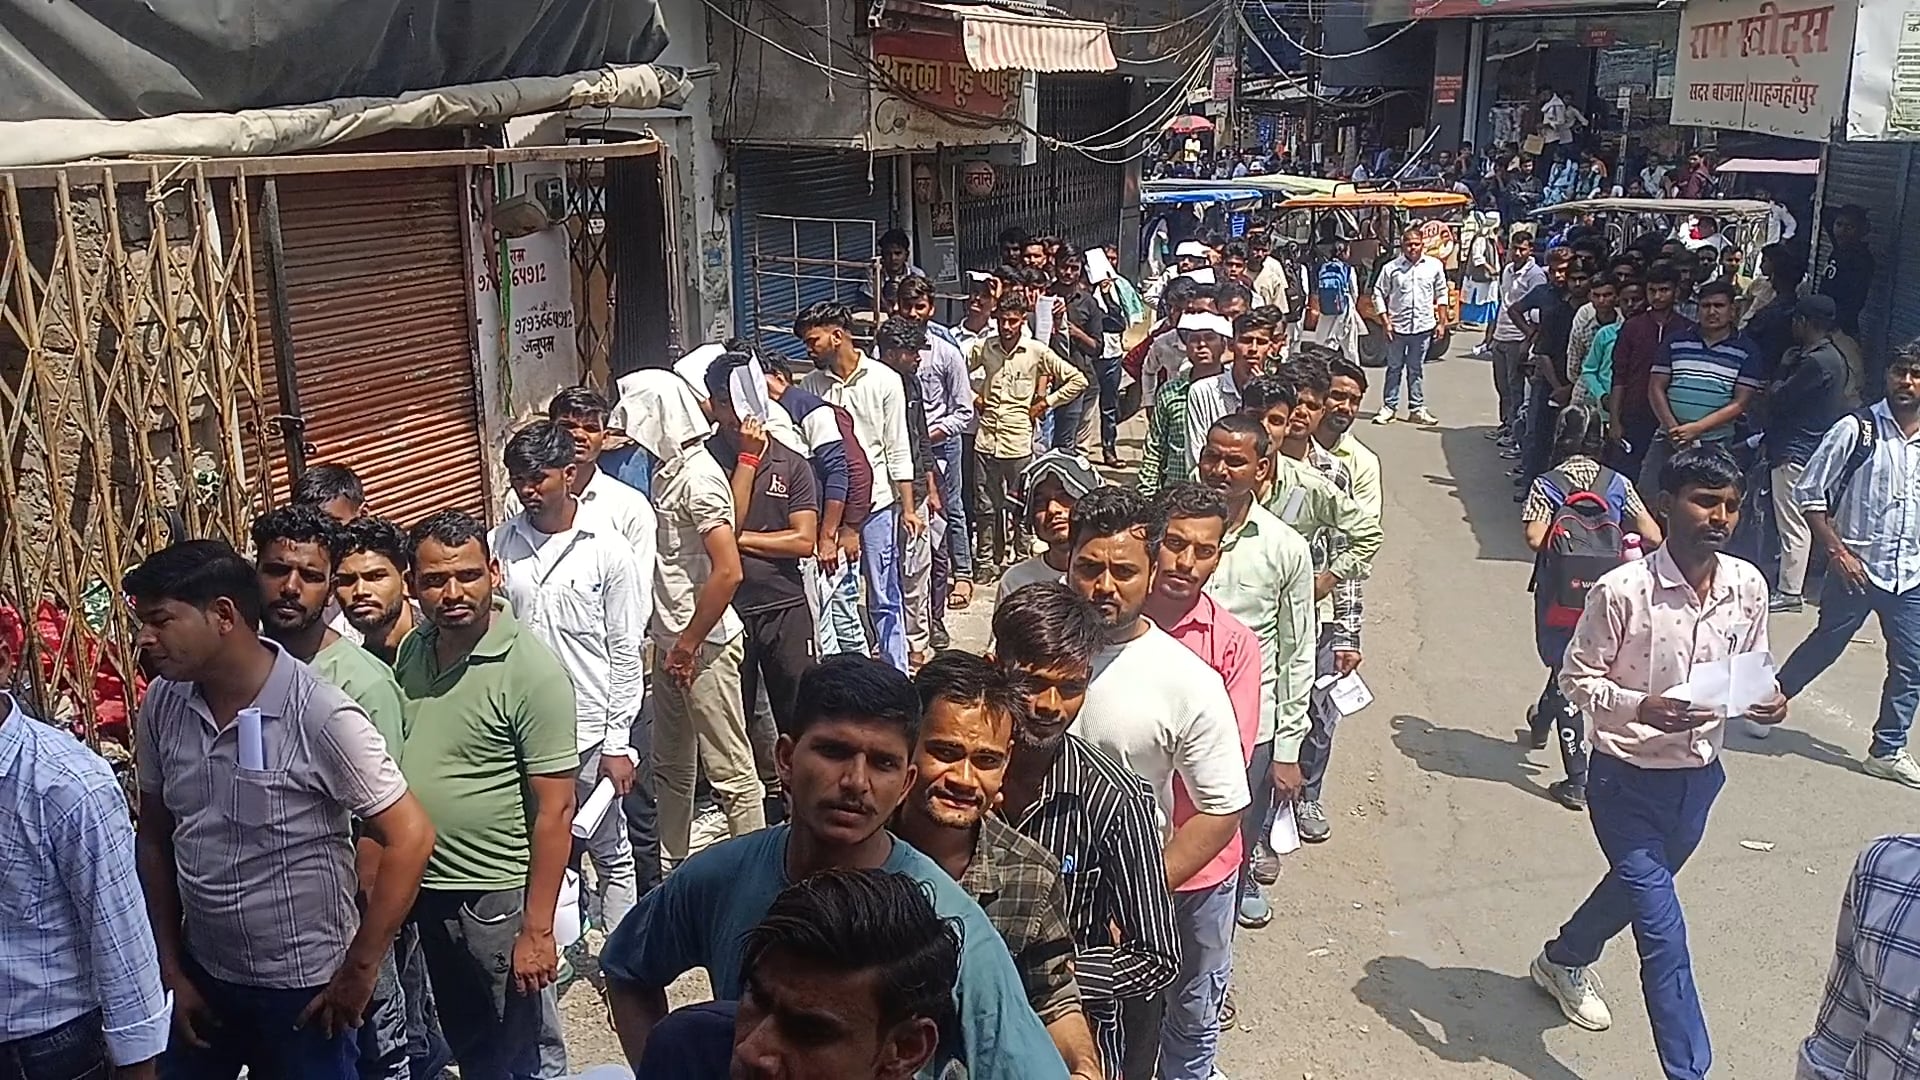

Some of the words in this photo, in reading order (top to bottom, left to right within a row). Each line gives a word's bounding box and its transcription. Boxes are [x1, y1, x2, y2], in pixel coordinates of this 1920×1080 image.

[1689, 21, 1733, 59] राम
[1689, 83, 1709, 101] सदर
[1712, 83, 1745, 102] बाजार
